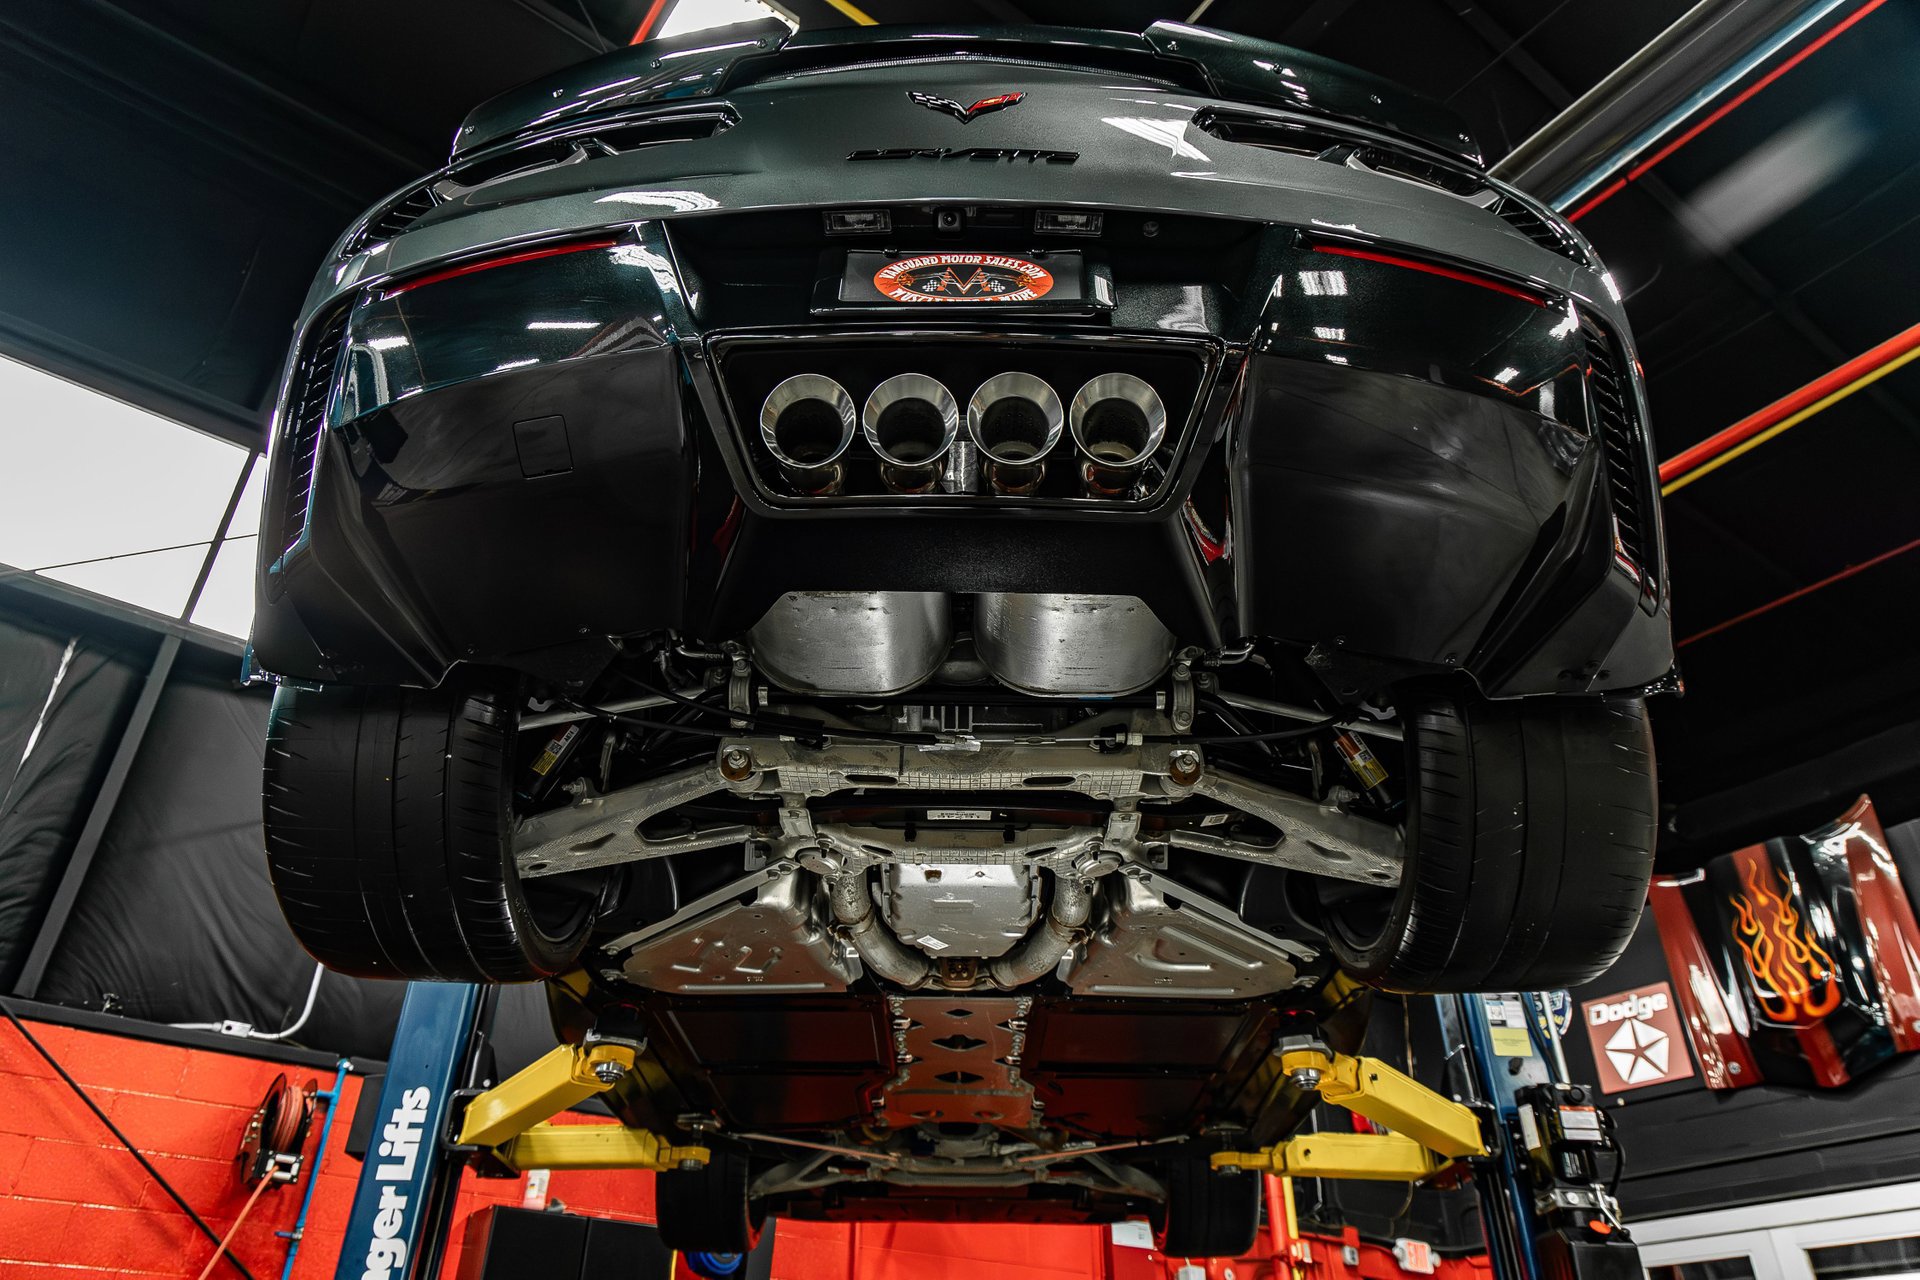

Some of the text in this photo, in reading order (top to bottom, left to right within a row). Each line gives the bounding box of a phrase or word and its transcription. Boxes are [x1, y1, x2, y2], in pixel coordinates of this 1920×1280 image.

[879, 255, 1047, 279] VANGUARD MOTOR SALES.COM
[1589, 993, 1668, 1026] Dodge
[361, 1086, 431, 1280] ger Lifts
